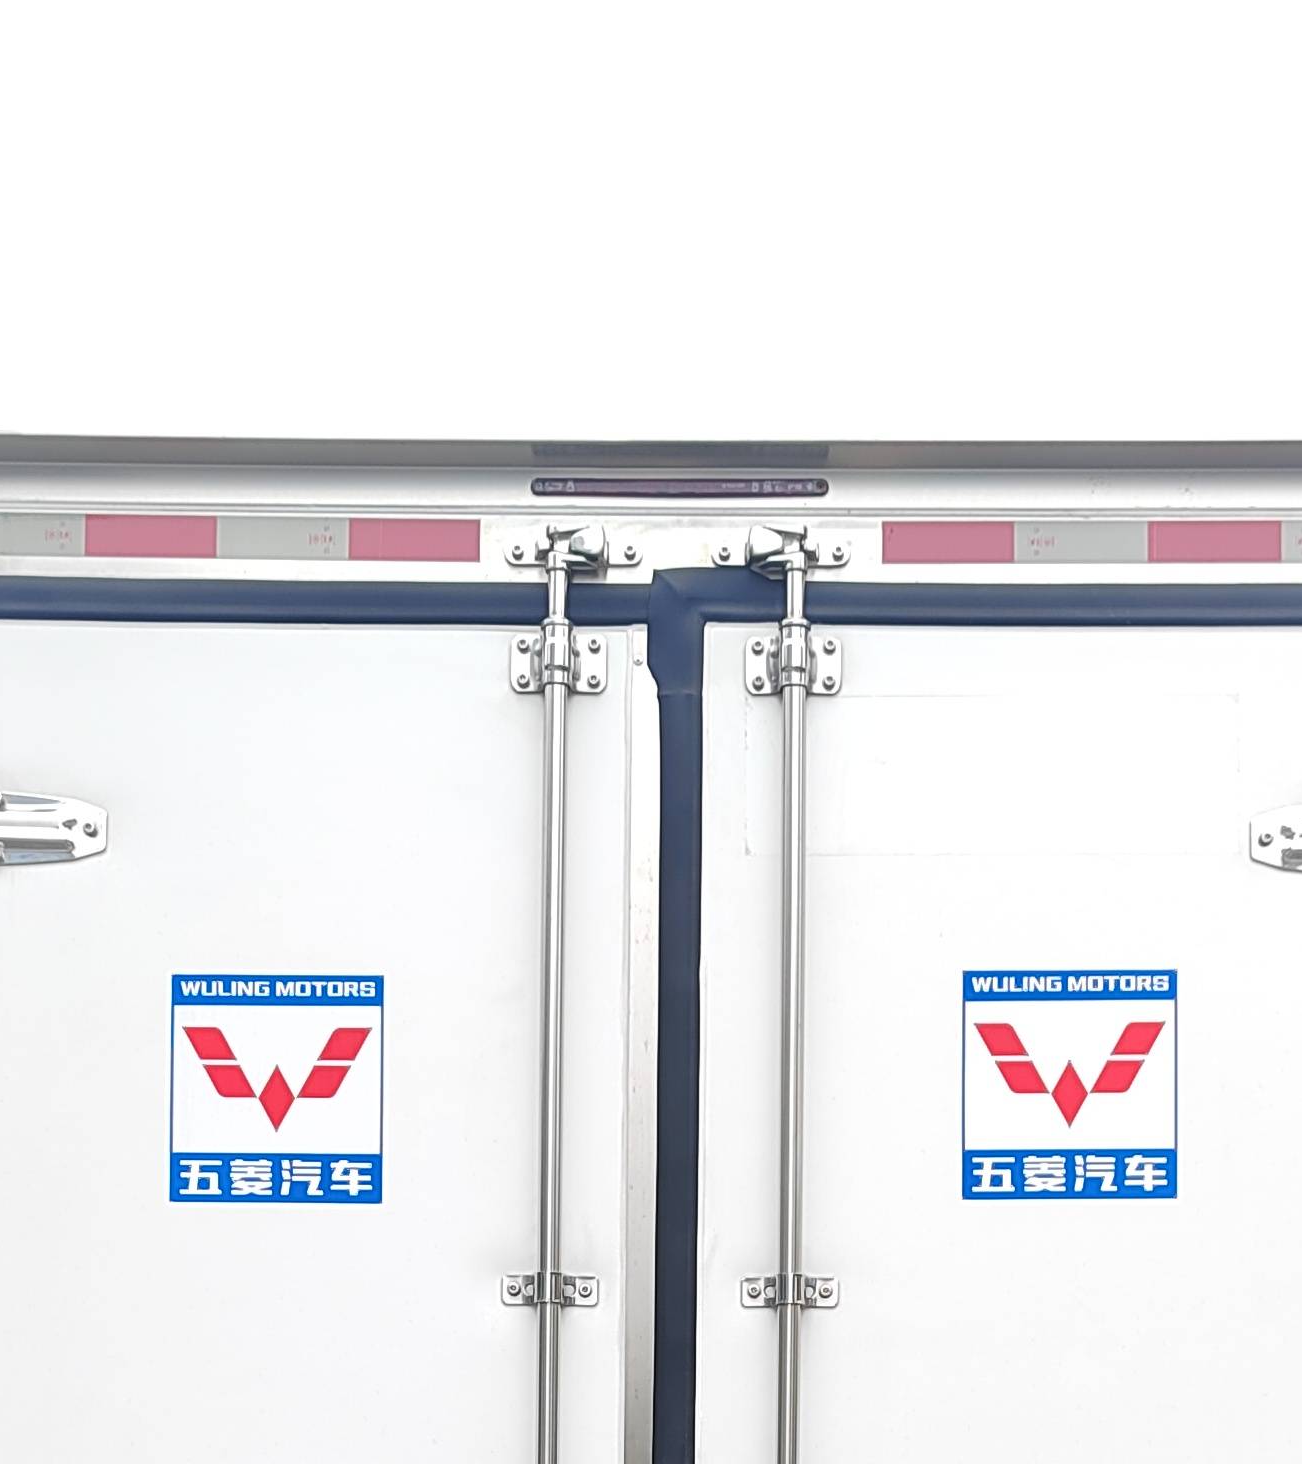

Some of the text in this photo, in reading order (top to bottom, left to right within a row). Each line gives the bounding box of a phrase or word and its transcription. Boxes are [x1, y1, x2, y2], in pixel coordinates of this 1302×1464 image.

[181, 980, 376, 998] WULING MOTORS
[971, 975, 1170, 993] WULING MOTORS
[179, 1158, 373, 1196] 五菱汽车
[971, 1154, 1169, 1192] 五菱汽车
